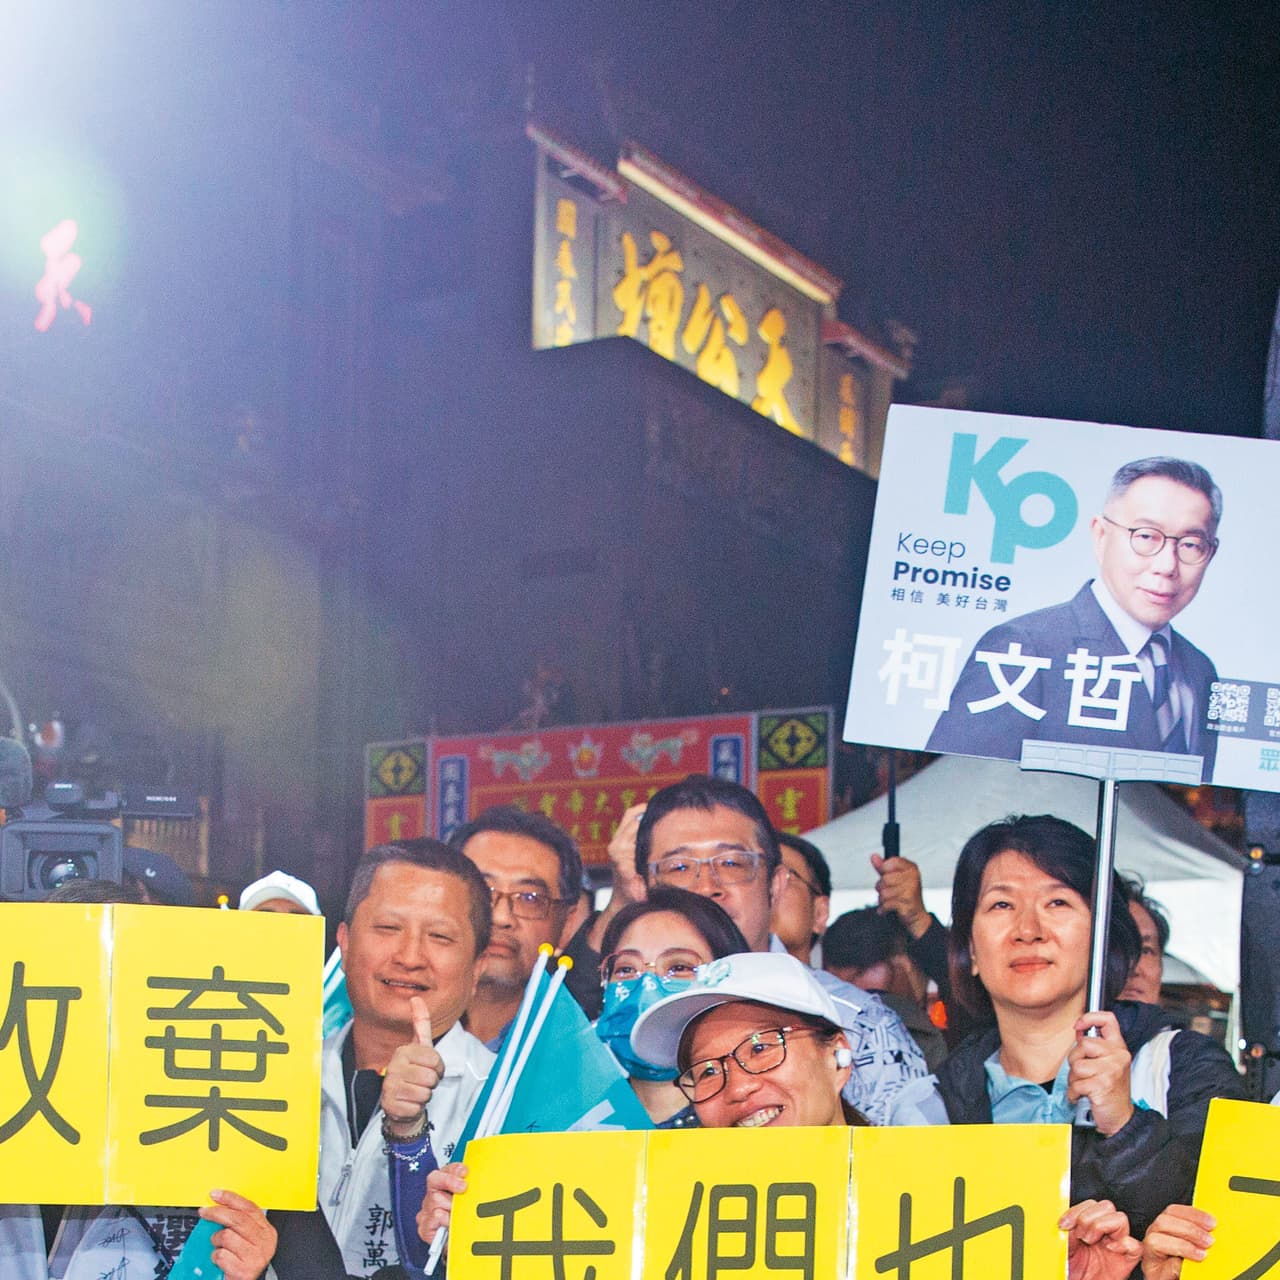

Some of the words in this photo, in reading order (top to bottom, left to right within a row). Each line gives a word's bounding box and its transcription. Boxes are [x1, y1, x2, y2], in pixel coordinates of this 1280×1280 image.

[896, 531, 966, 563] Keep
[893, 561, 1011, 592] Promise
[890, 588, 924, 604] 相信
[936, 592, 1009, 612] 美好台灣
[878, 628, 1142, 731] 柯文哲
[363, 1204, 395, 1270] 郭萬
